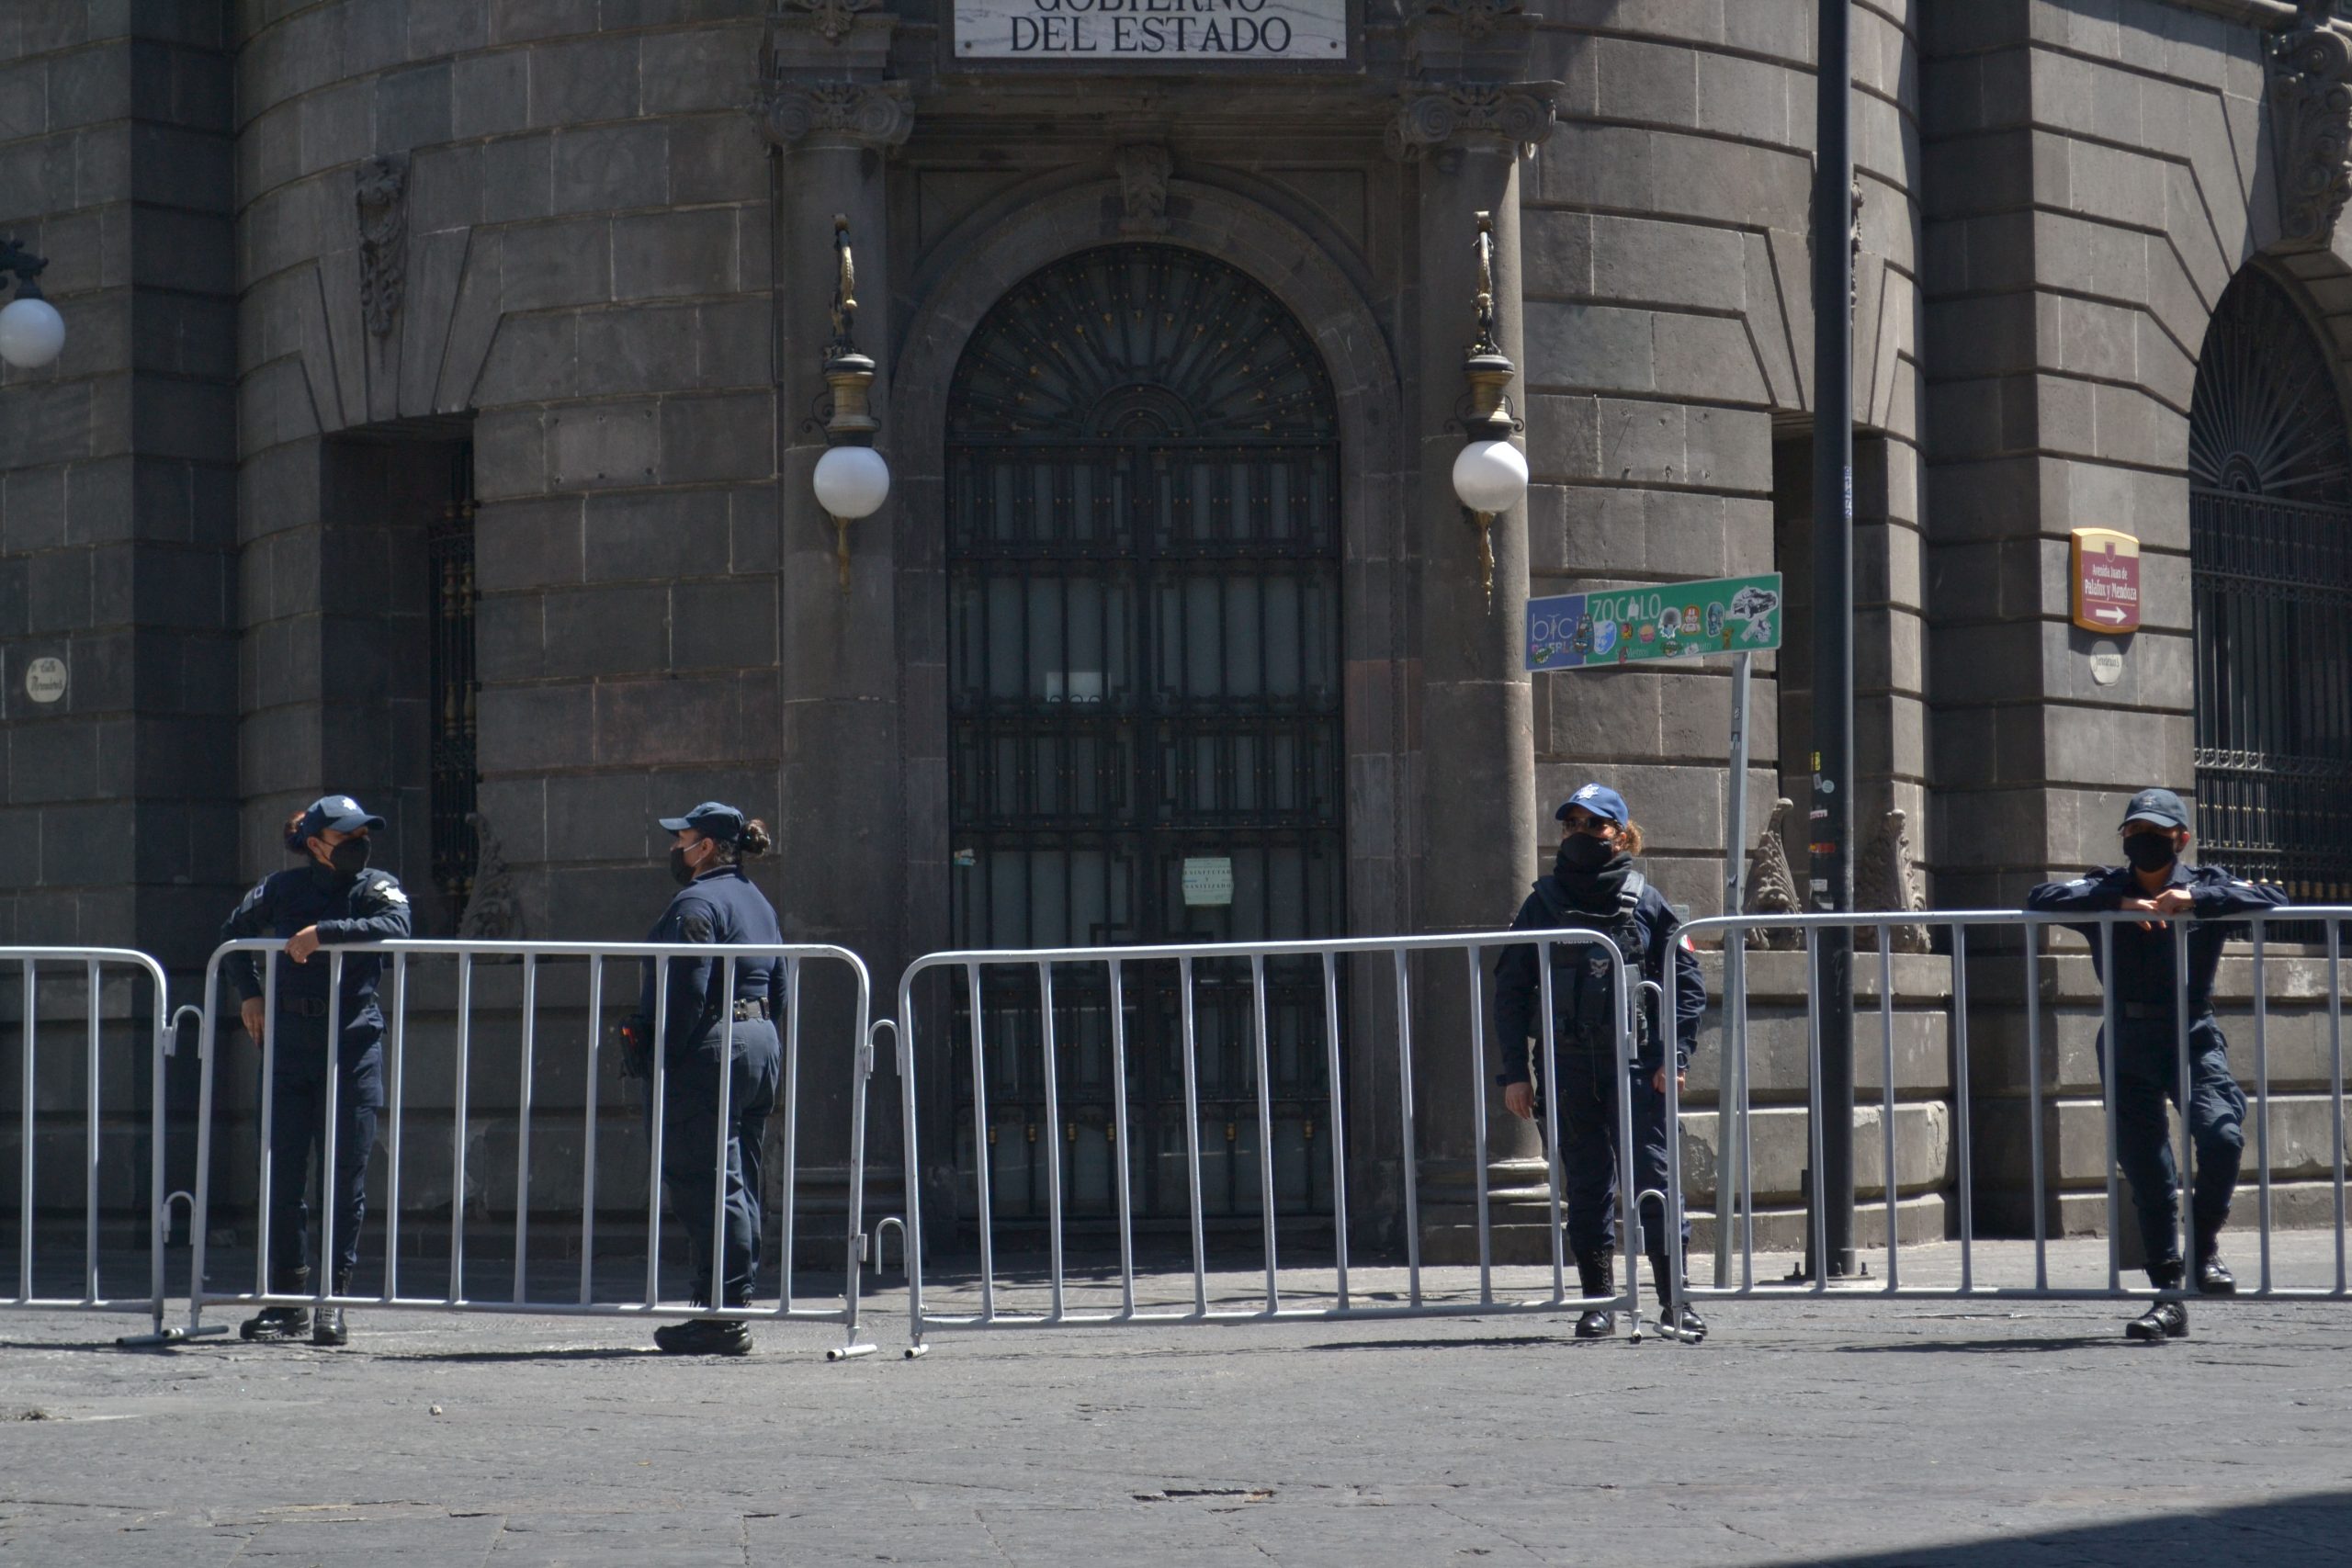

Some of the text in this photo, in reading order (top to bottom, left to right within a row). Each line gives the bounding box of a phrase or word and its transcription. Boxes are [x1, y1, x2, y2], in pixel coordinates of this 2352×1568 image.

[1011, 16, 1292, 52] DEL ESTADO
[2092, 564, 2128, 581] Avenida Juan de
[2085, 579, 2137, 602] Palafox y Mendoza
[1592, 593, 1661, 622] ZOCALO
